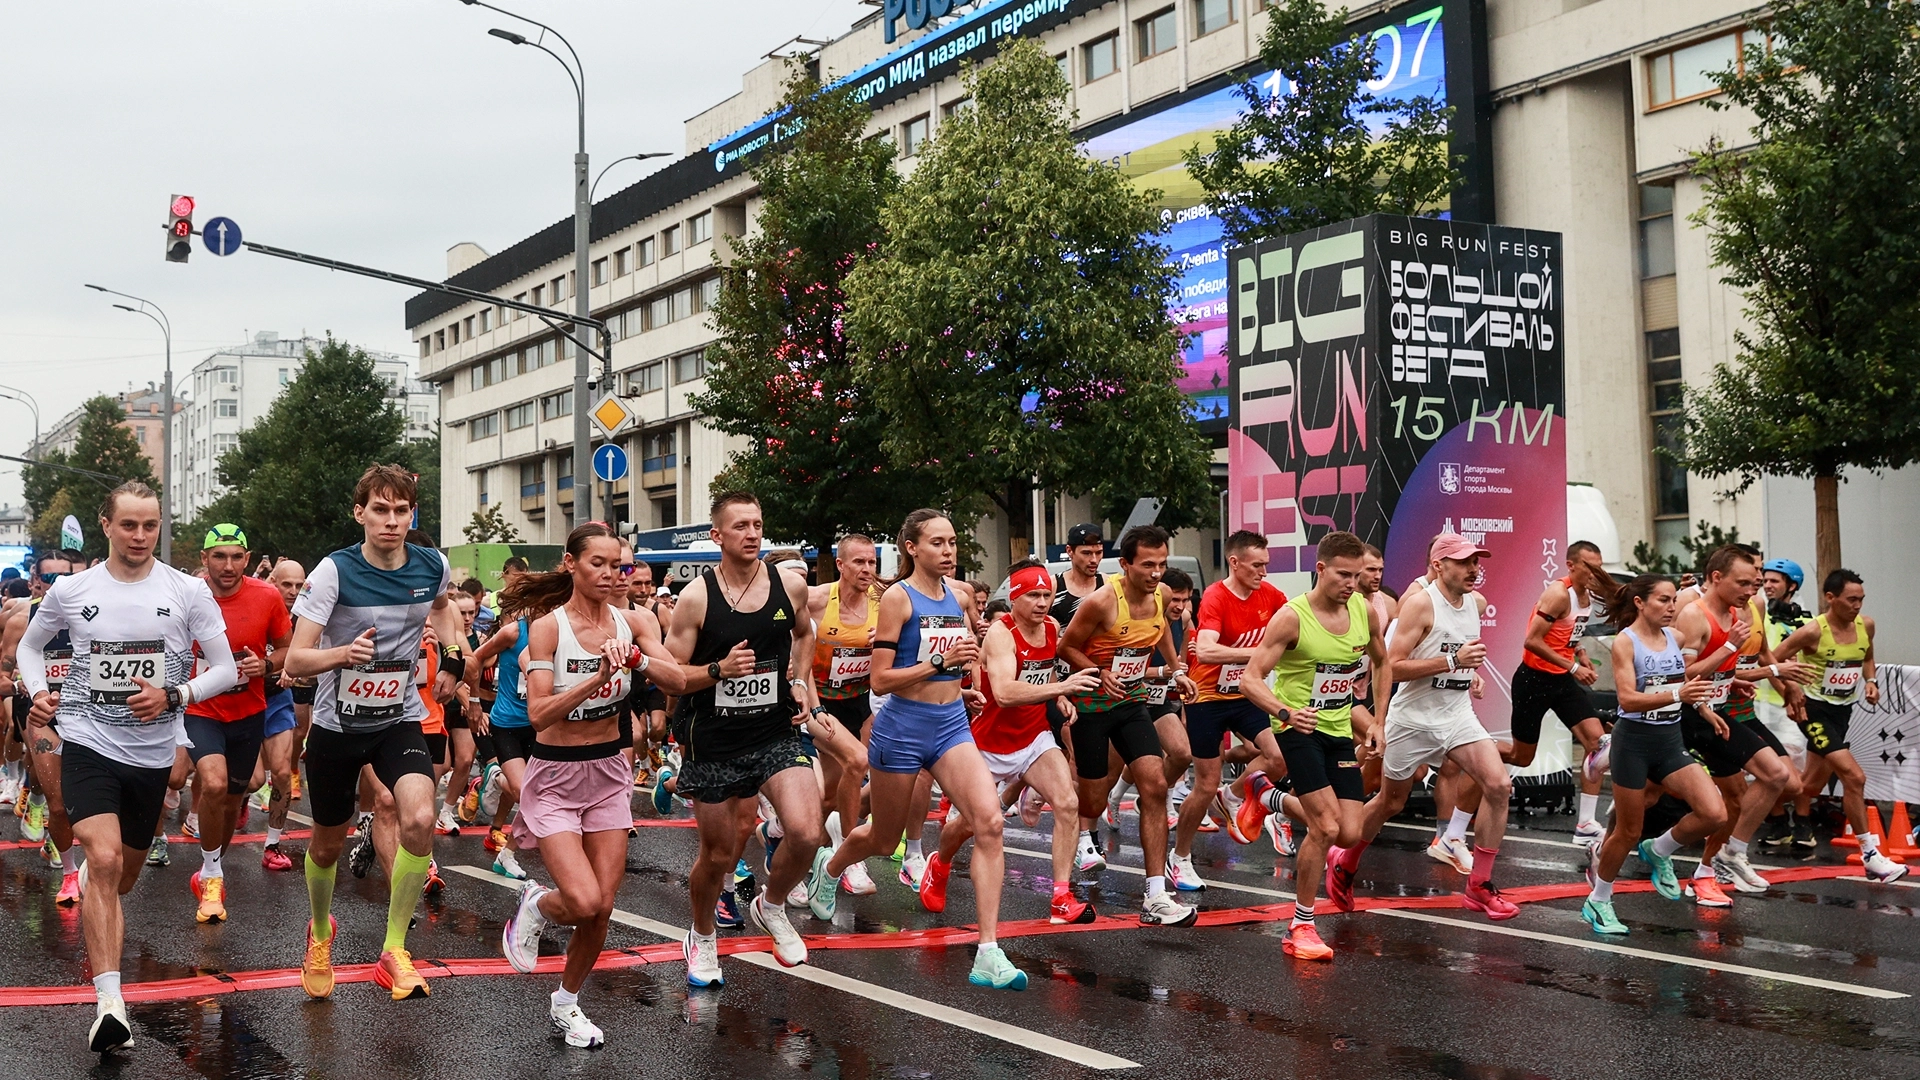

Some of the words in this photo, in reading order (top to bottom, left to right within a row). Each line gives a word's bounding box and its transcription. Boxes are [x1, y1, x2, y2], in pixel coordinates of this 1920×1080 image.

[889, 51, 925, 88] МИД
[929, 25, 986, 68] назвал
[725, 149, 738, 163] РИА
[738, 133, 769, 156] НОВОСТИ
[1390, 230, 1428, 246] BIG
[1441, 235, 1486, 252] RUN
[1500, 242, 1552, 259] FEST
[1238, 230, 1365, 356] BIG
[1390, 259, 1553, 311] БОЛЬШОЙ
[1390, 299, 1554, 351] ФЕСТИВАЛЬ
[1391, 344, 1490, 388] БЕГА
[1239, 346, 1367, 464] RUN
[1390, 395, 1446, 441] 15
[1467, 398, 1555, 447] КМ
[1463, 465, 1506, 474] Департамент
[1464, 475, 1487, 484] спорта
[1464, 485, 1487, 494] города
[1487, 485, 1513, 494] Москвы
[1240, 464, 1367, 574] FEST
[1460, 516, 1514, 533] МОСКОВСКИЙ
[679, 564, 718, 578] СТО
[99, 659, 155, 680] 3478
[837, 660, 870, 675] 6442
[112, 680, 140, 688] НИКИТ
[347, 678, 400, 699] 4942
[724, 678, 771, 698] 3208
[1829, 672, 1859, 685] 6669
